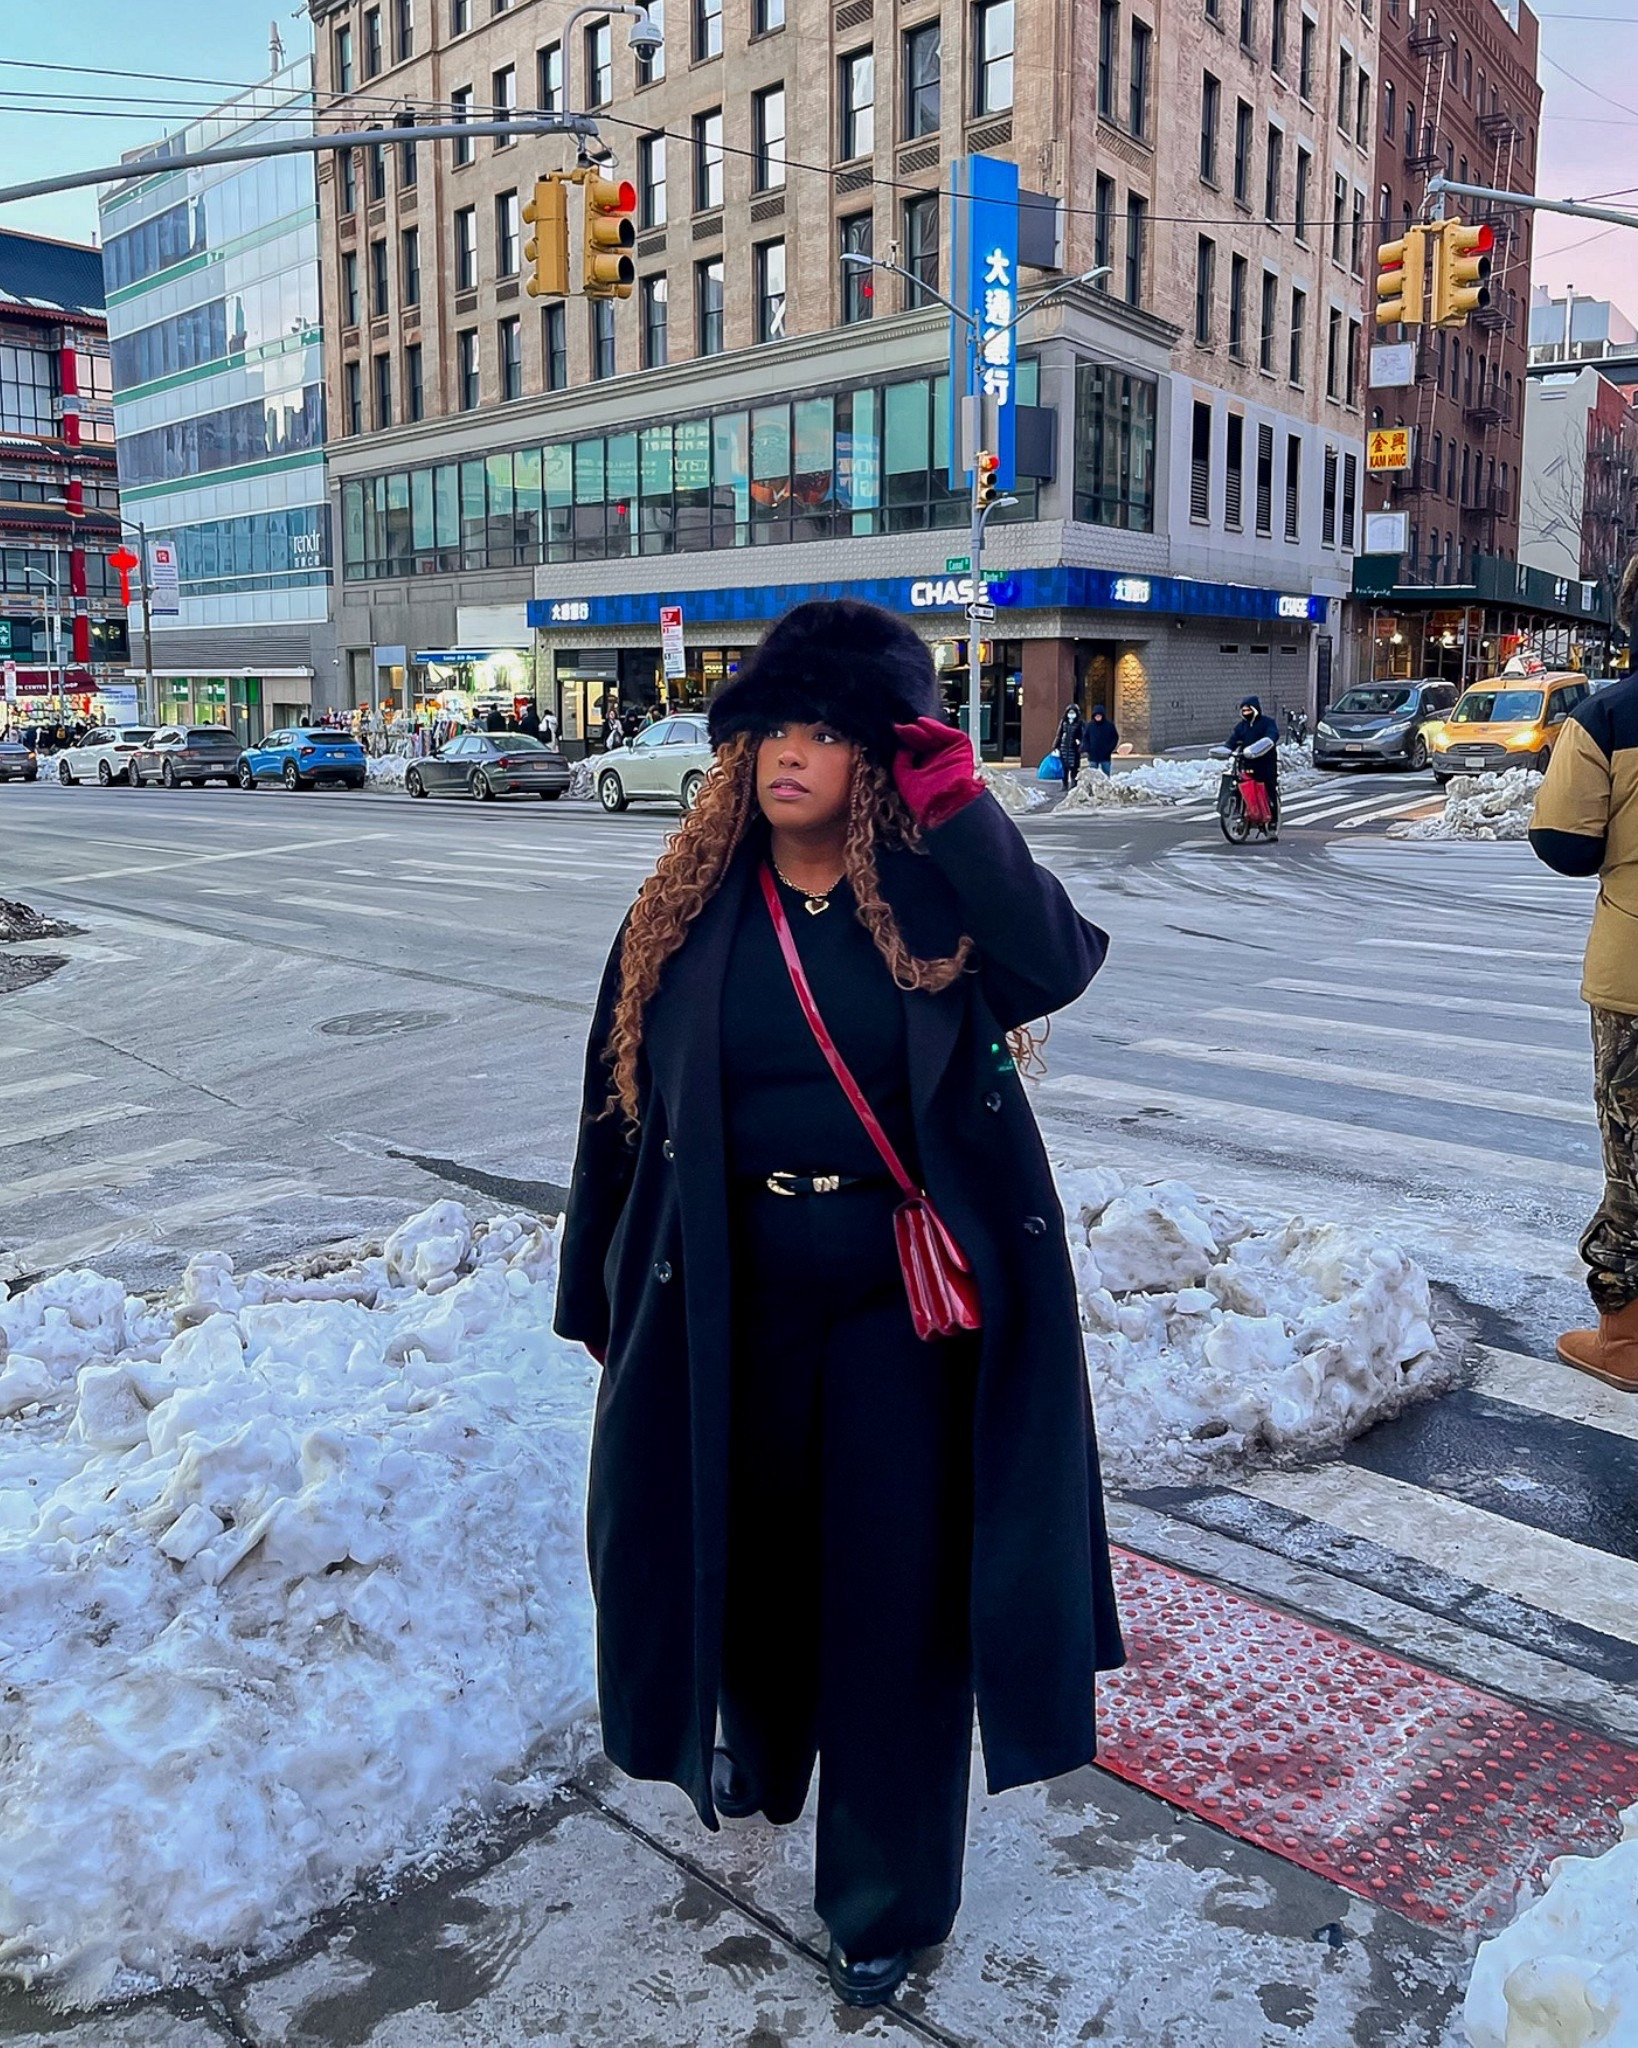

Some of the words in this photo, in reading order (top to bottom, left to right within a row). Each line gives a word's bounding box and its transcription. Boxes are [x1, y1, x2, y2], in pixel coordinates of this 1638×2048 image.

[1370, 455, 1386, 468] KAM
[1388, 453, 1406, 467] HING
[293, 529, 320, 554] rendr
[911, 579, 989, 606] CHASE
